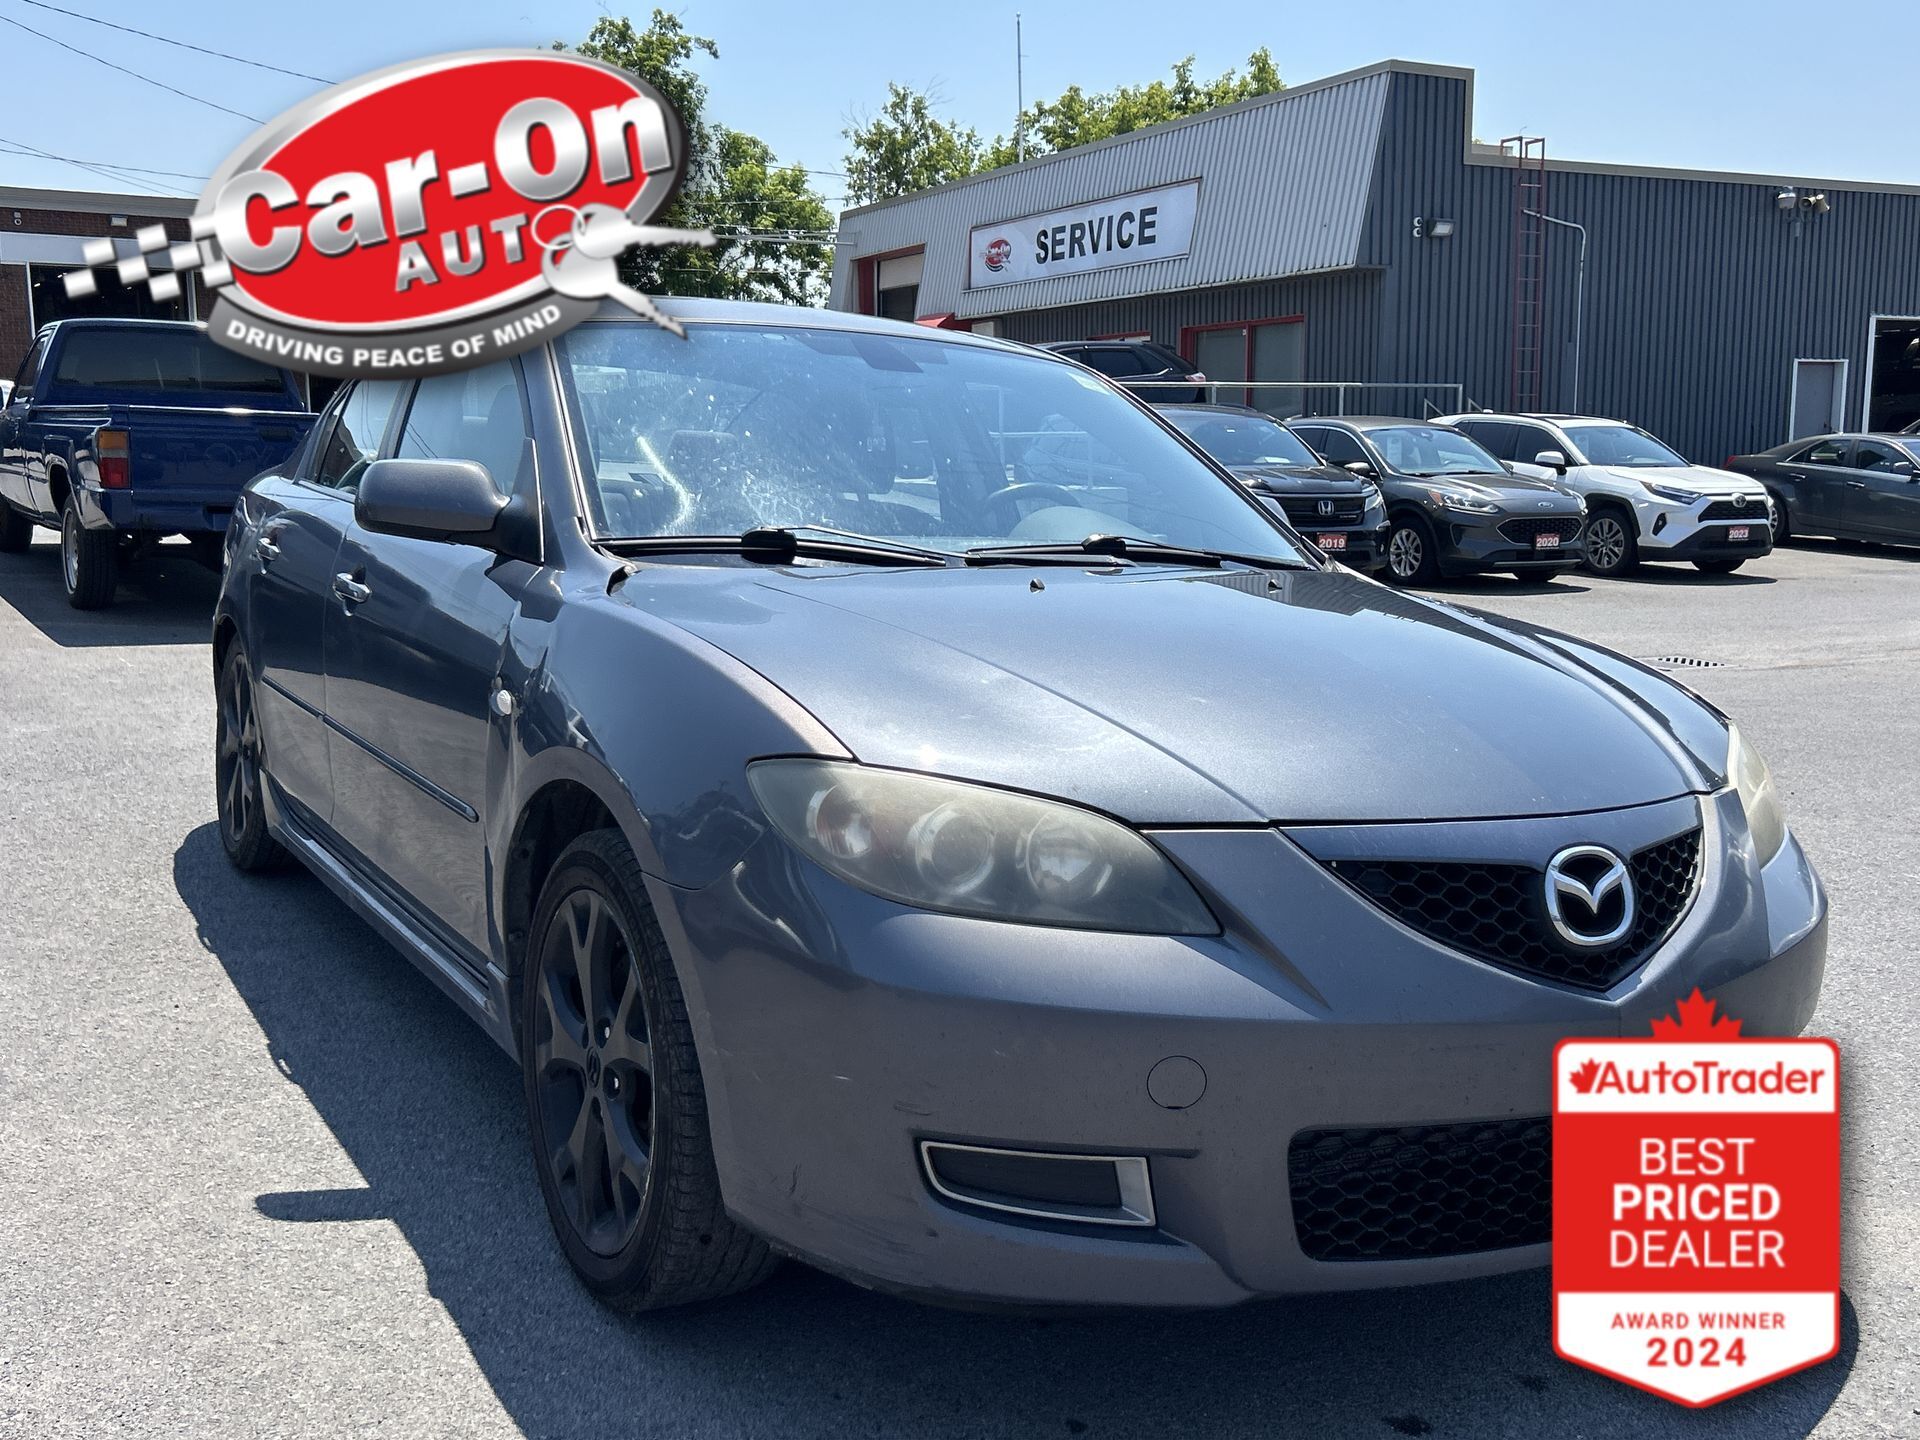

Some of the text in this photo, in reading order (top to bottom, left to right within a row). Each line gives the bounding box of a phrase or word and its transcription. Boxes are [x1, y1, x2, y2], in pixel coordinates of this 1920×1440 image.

[1035, 206, 1158, 265] SERVICE
[1728, 529, 1749, 539] 2023
[1318, 538, 1346, 549] 2019
[1536, 537, 1559, 547] 2020
